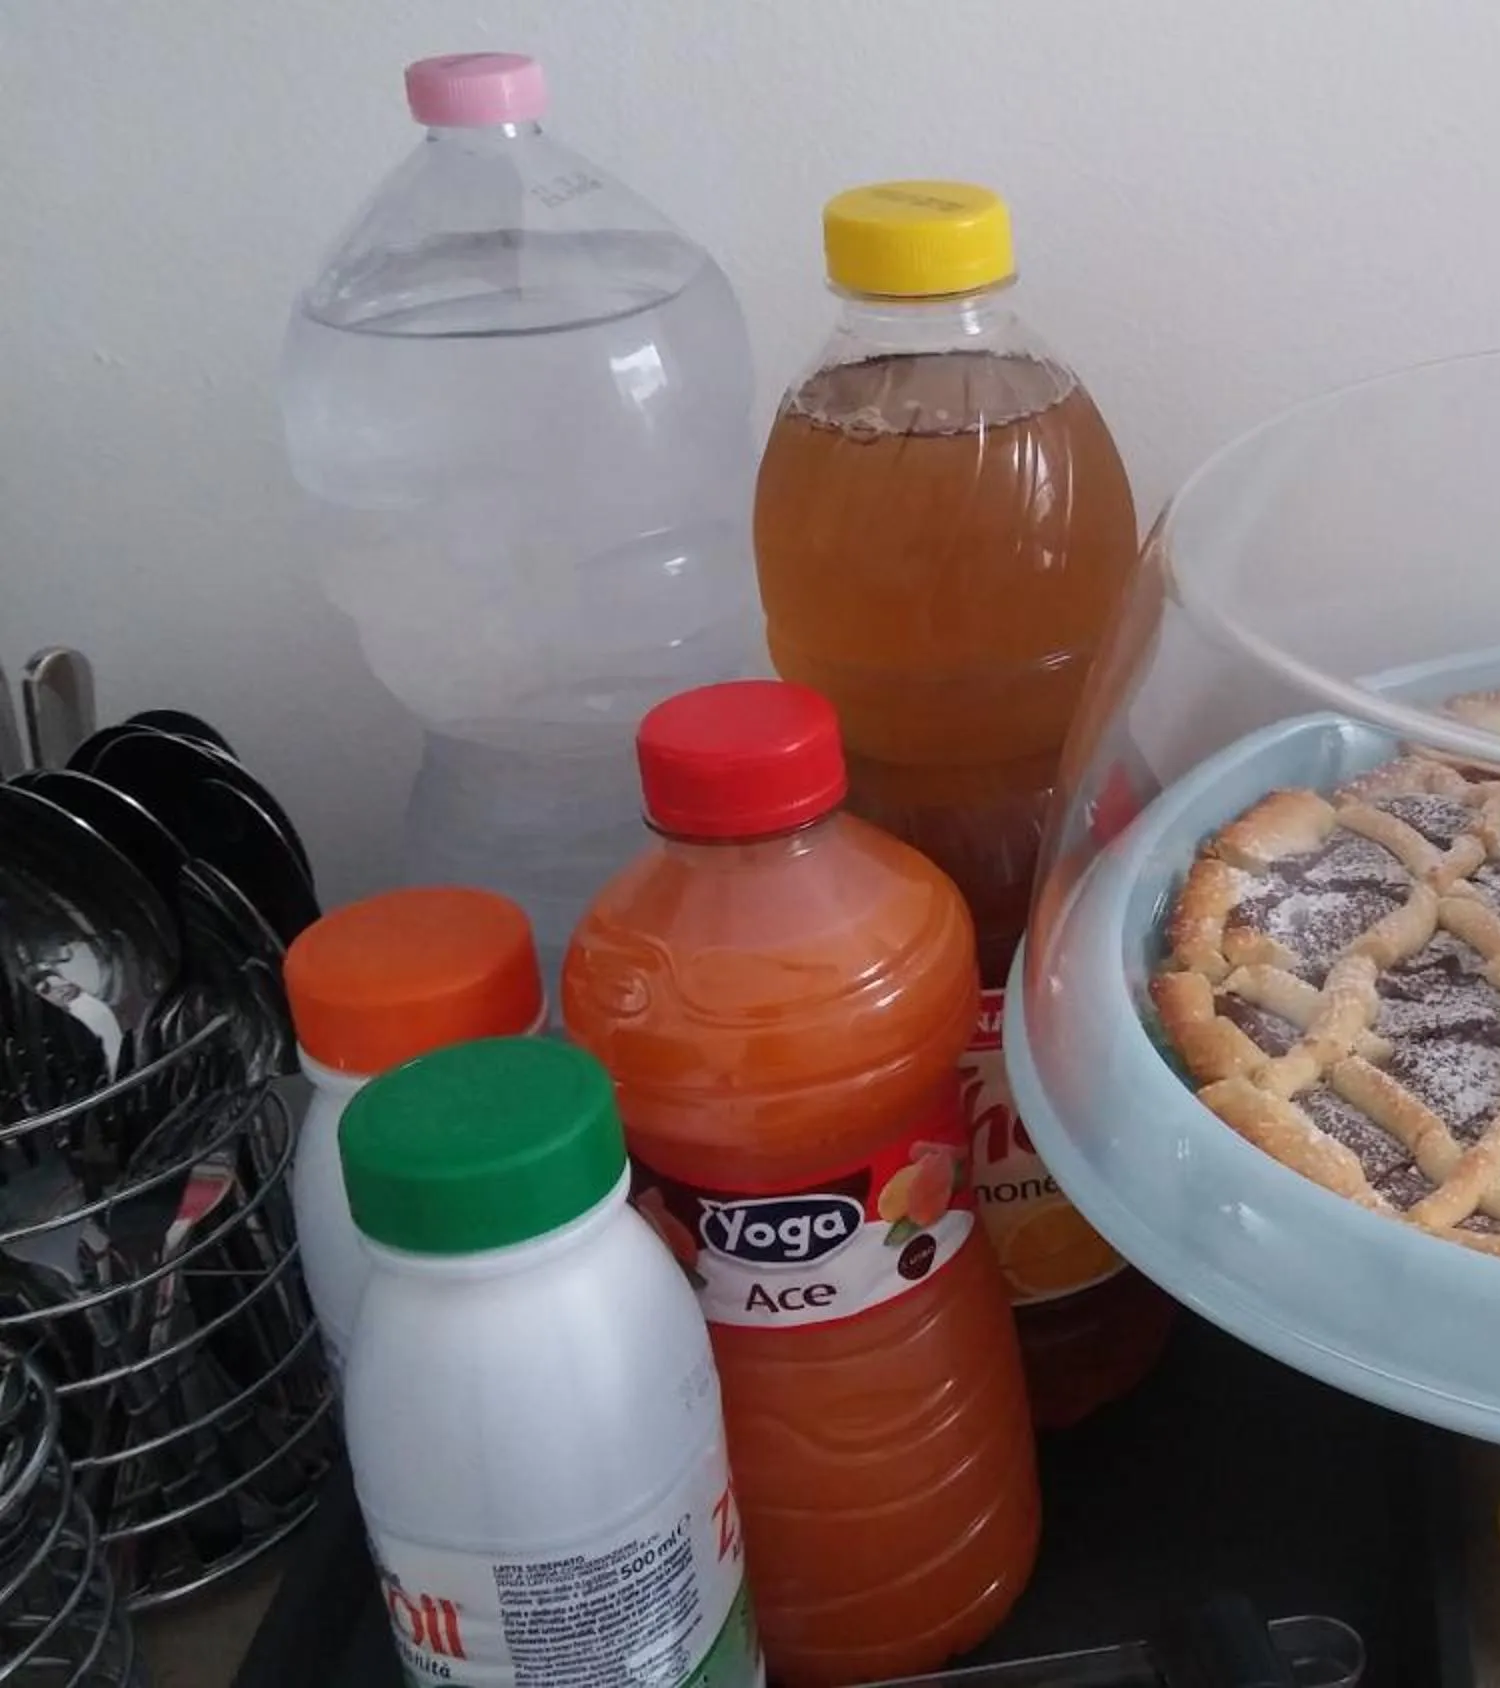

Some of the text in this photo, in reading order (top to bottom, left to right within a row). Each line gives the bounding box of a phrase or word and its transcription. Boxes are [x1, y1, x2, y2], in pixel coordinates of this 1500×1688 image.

[716, 1208, 850, 1258] Yoga
[745, 1282, 838, 1313] Ace
[620, 1550, 656, 1581] 500
